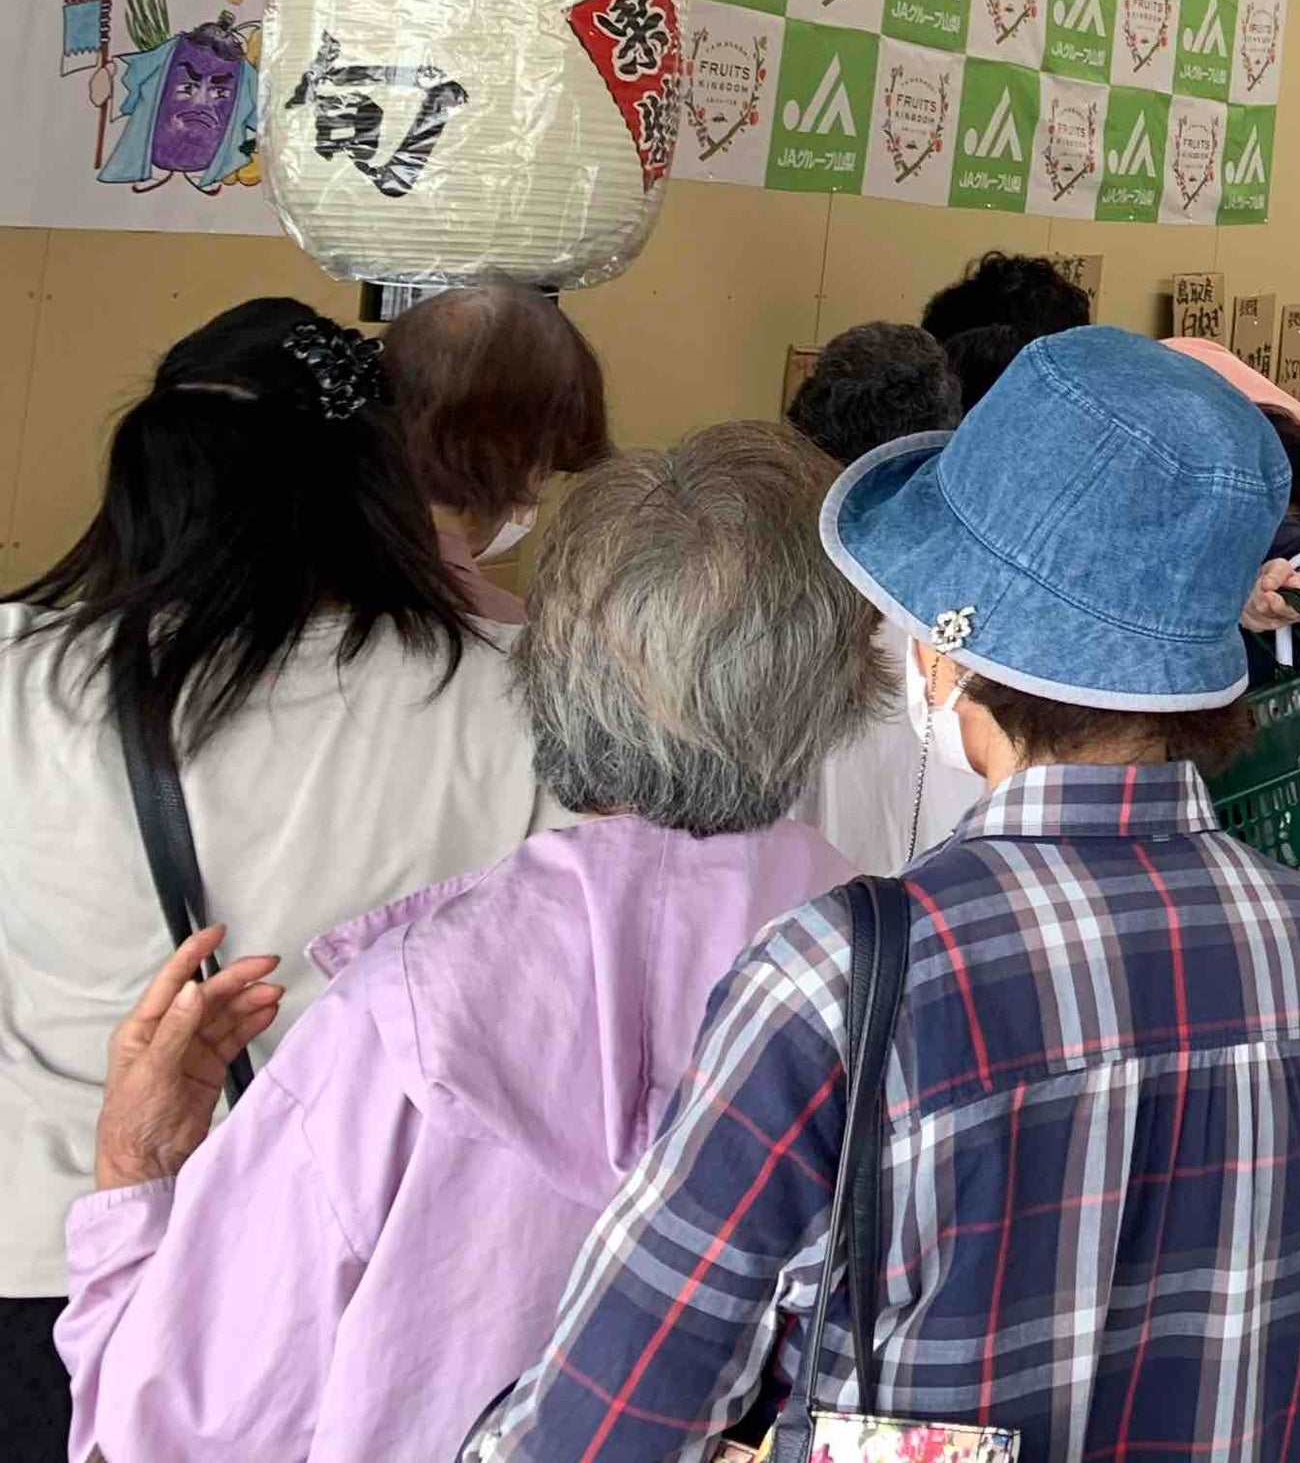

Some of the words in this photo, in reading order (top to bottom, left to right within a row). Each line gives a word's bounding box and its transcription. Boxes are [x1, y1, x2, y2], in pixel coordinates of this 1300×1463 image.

[891, 1, 961, 34] JAグループ山梨
[1051, 41, 1106, 67] JAグループ山梨
[699, 60, 751, 81] FRUITS
[698, 79, 750, 94] KINGDOM
[896, 93, 937, 113] FRUITS
[777, 147, 857, 173] JAグループ山梨
[958, 170, 1023, 194] JAグループ山梨
